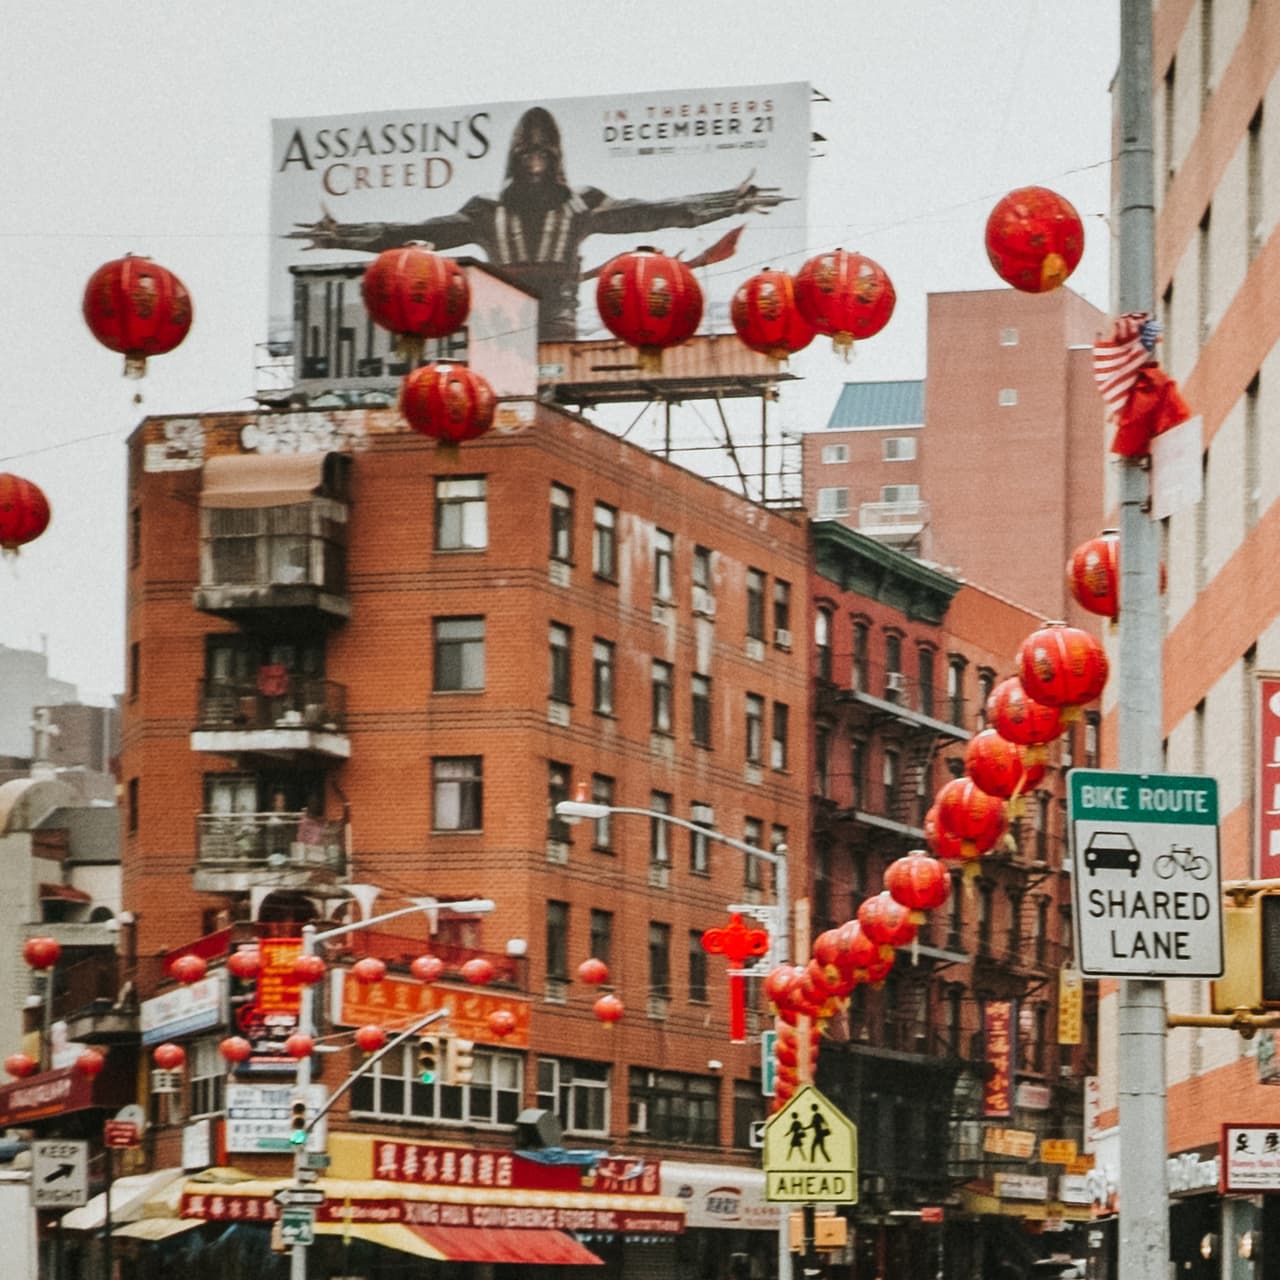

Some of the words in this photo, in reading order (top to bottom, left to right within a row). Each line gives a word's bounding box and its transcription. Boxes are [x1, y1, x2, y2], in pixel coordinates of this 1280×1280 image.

[603, 110, 627, 120] IN
[647, 100, 775, 117] THEATERS
[604, 118, 742, 142] DECEMBER
[752, 116, 773, 133] 21
[323, 157, 454, 196] CREED
[1081, 786, 1129, 810] BIKE
[1138, 788, 1209, 813] ROUTE
[1088, 888, 1211, 921] SHARED
[1111, 930, 1192, 961] LANE
[39, 1145, 80, 1158] KEEP
[36, 1188, 82, 1201] RIGHT
[775, 1177, 846, 1196] AHEAD
[403, 1201, 440, 1223] XING
